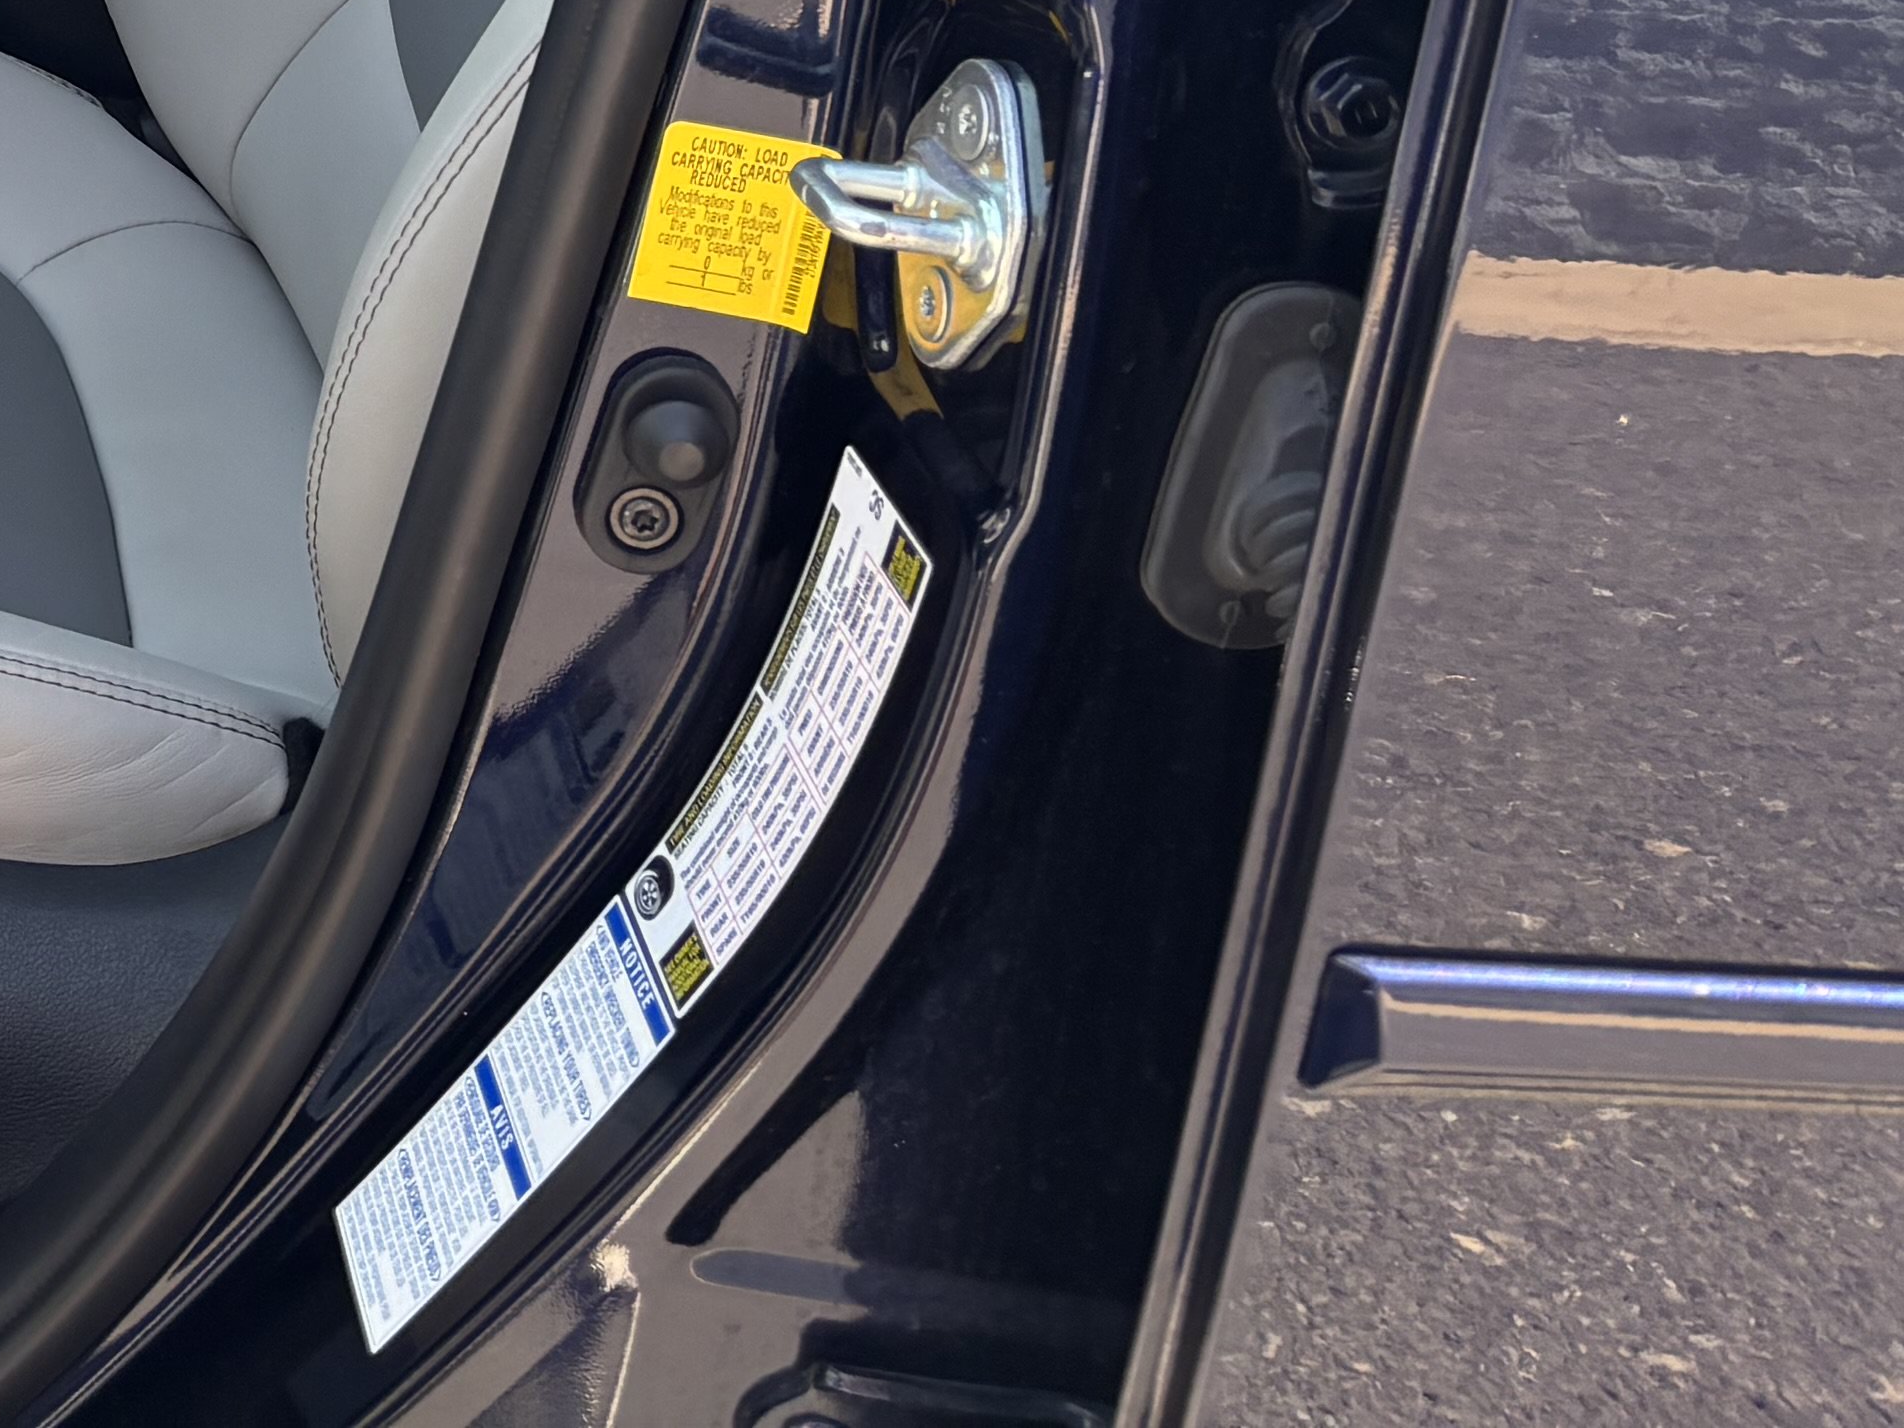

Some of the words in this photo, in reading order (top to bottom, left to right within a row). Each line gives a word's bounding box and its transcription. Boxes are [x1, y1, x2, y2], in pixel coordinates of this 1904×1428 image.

[671, 151, 733, 175] CARRYING
[739, 163, 791, 185] CAPACIT
[691, 136, 748, 160] CAUTION:
[755, 148, 789, 167] LOAD
[690, 169, 747, 193] REDUCED
[618, 935, 655, 1011] NOTICE
[560, 1048, 581, 1086] YOUR
[488, 1099, 515, 1152] AVIS
